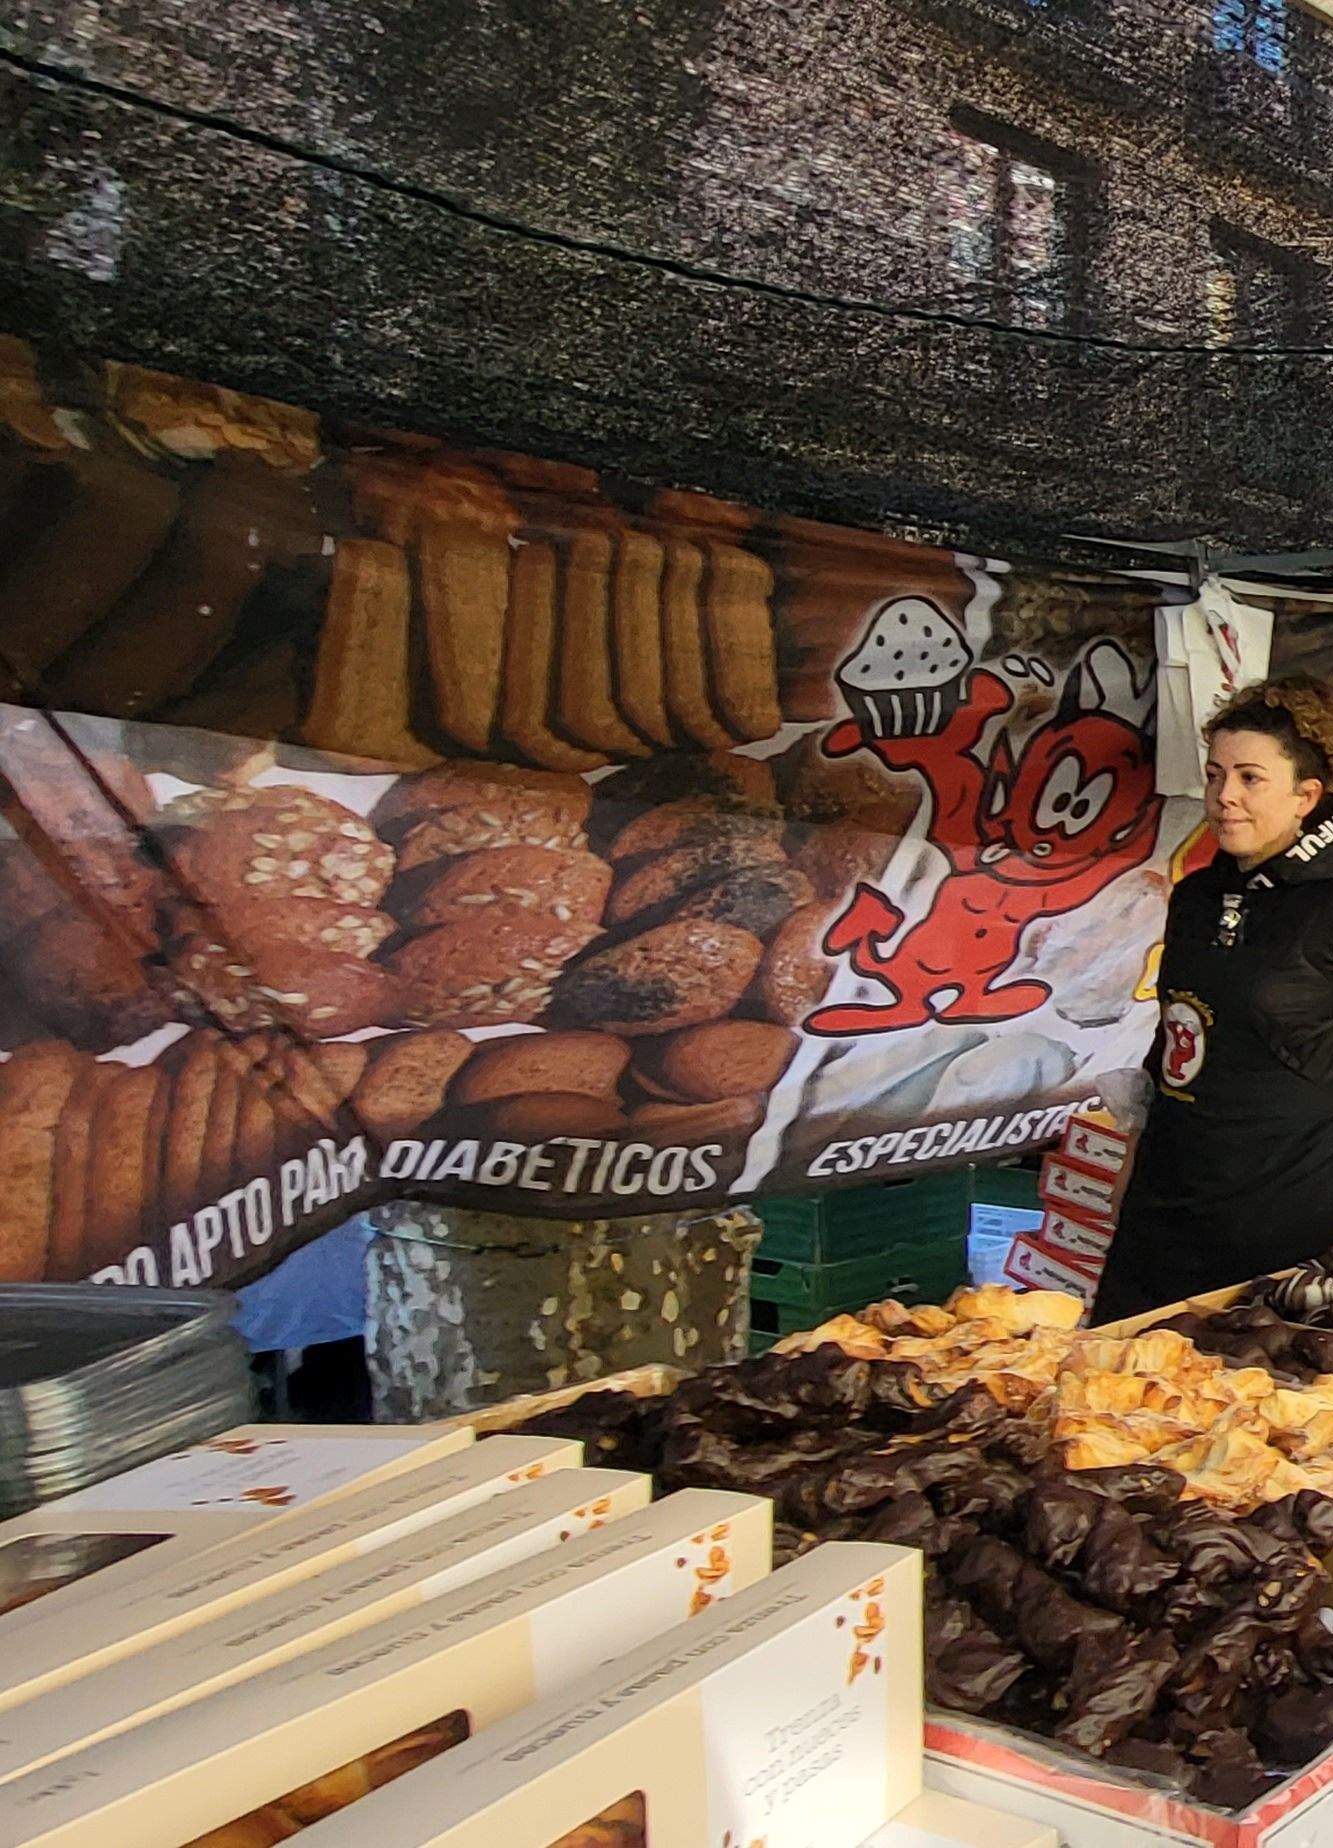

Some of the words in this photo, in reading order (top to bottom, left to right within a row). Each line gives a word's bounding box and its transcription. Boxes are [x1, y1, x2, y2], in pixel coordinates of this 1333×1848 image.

[170, 1177, 273, 1288] APTO
[727, 1594, 807, 1634] Trenza
[686, 1634, 731, 1658] con
[619, 1658, 687, 1698] pasas
[502, 1709, 601, 1763] nueces
